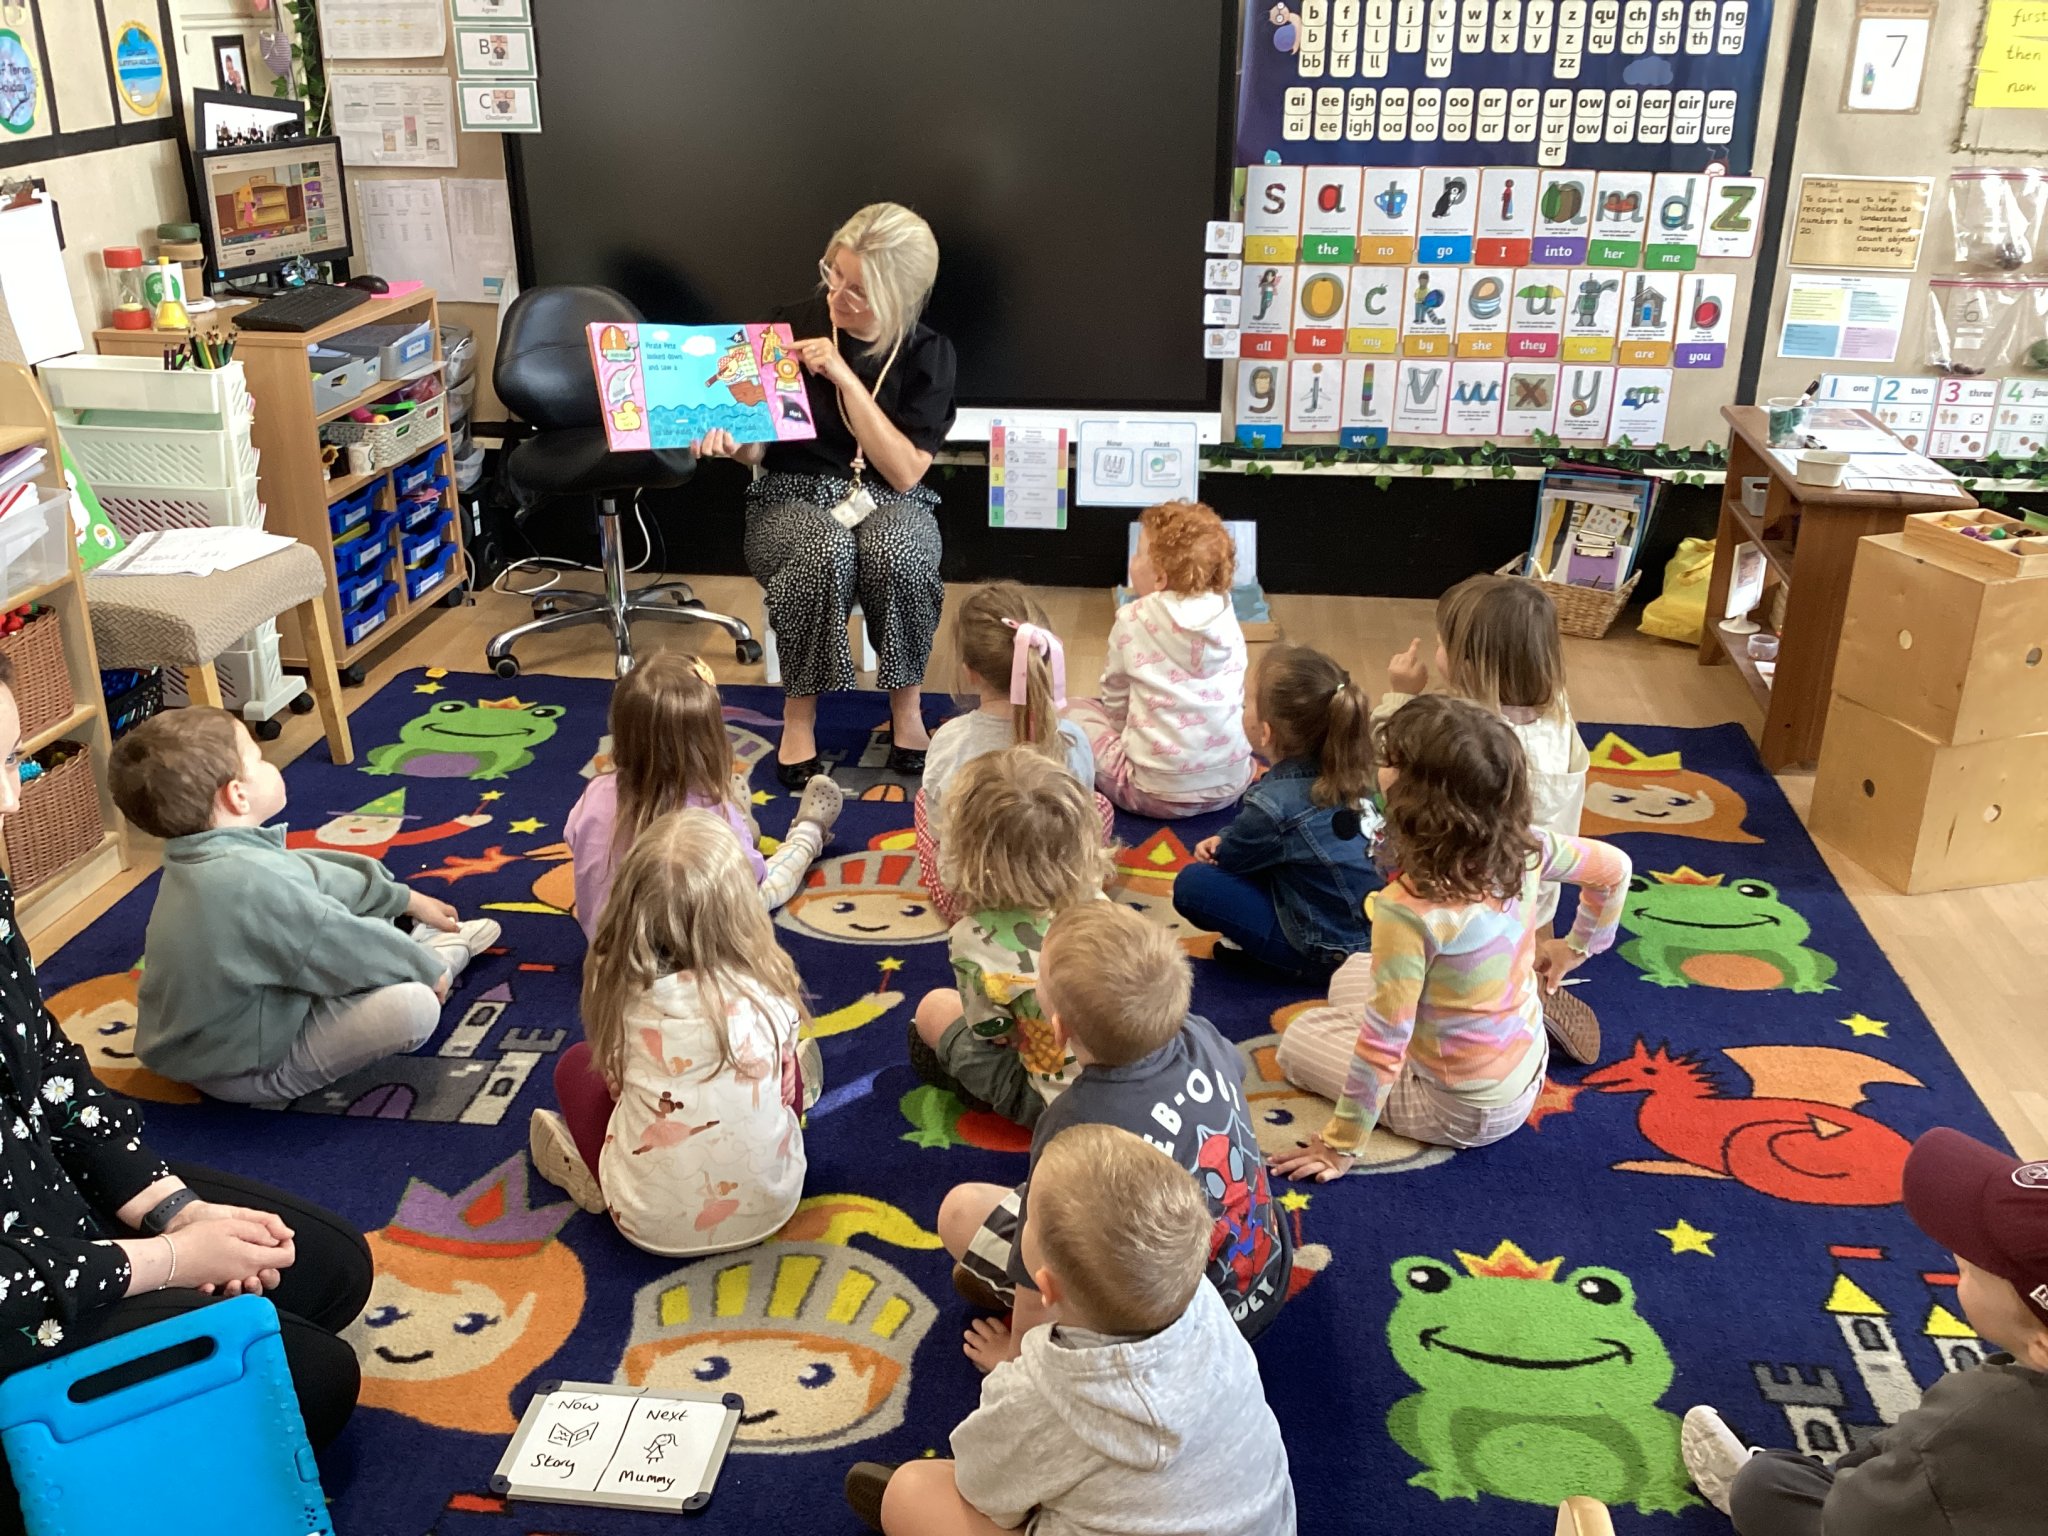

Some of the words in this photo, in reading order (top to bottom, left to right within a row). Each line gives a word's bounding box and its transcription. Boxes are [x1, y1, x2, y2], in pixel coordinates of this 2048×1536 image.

[1309, 6, 1319, 19] b
[1343, 6, 1351, 19] f
[1375, 6, 1382, 19] l
[1406, 6, 1413, 24] j
[1438, 10, 1447, 19] v
[1468, 10, 1482, 19] w
[1502, 9, 1512, 20] x
[1535, 10, 1545, 24] y
[1569, 10, 1576, 20] z
[1595, 10, 1616, 24] qu
[1629, 7, 1647, 21] ch
[1662, 7, 1679, 21] sh
[1695, 7, 1712, 22] th
[1725, 10, 1745, 25] ng
[479, 39, 490, 54] B
[1308, 30, 1318, 42] b
[1342, 30, 1348, 42] f
[1374, 30, 1380, 43] l
[1405, 30, 1411, 47] j
[1437, 33, 1446, 43] v
[1466, 33, 1479, 43] w
[1500, 33, 1510, 43] x
[1533, 34, 1542, 48] y
[1566, 34, 1574, 44] z
[1593, 34, 1612, 49] qu
[1627, 32, 1644, 45] ch
[1659, 32, 1676, 45] sh
[1692, 32, 1708, 45] th
[1722, 35, 1742, 49] ng
[1886, 35, 1908, 68] 7
[2006, 45, 2041, 60] then
[1302, 56, 1321, 68] bb
[1337, 56, 1350, 68] ff
[1370, 56, 1380, 68] ll
[1431, 58, 1447, 67] vv
[1560, 59, 1575, 68] zz
[2007, 81, 2036, 93] now
[480, 93, 491, 109] C
[1291, 93, 1306, 106] ai
[1321, 97, 1339, 107] ee
[1350, 94, 1374, 110] igh
[1385, 97, 1405, 107] oa
[1417, 97, 1436, 107] oo
[1450, 97, 1469, 107] oo
[1484, 97, 1501, 107] ar
[1516, 97, 1534, 108] or
[1550, 98, 1567, 108] ur
[1578, 98, 1603, 108] ow
[1616, 96, 1631, 109] oi
[1643, 98, 1670, 109] ear
[1678, 96, 1701, 110] air
[1709, 99, 1734, 110] ure
[1290, 119, 1303, 132] ai
[1320, 122, 1337, 132] ee
[1349, 119, 1372, 136] igh
[1383, 123, 1402, 132] oa
[1416, 123, 1434, 132] oo
[1447, 123, 1466, 132] oo
[1482, 123, 1498, 133] ar
[1514, 123, 1531, 133] or
[1547, 123, 1564, 134] ur
[1576, 124, 1599, 134] ow
[1613, 121, 1627, 134] oi
[1641, 124, 1666, 135] ear
[1675, 122, 1696, 135] air
[1706, 124, 1731, 135] ure
[1545, 146, 1560, 156] er
[1264, 246, 1276, 254] to
[1318, 243, 1339, 255] the
[1378, 246, 1394, 255] no
[1437, 246, 1453, 258] go
[1500, 247, 1506, 257] I
[1545, 246, 1572, 256] into
[1604, 248, 1624, 259] her
[1662, 254, 1680, 262] me
[1256, 340, 1271, 351] all
[1312, 336, 1326, 346] he
[1363, 338, 1381, 347] my
[1419, 340, 1434, 351] by
[1472, 340, 1492, 349] she
[1520, 340, 1546, 352] they
[1580, 346, 1596, 354] we
[1635, 350, 1654, 358] are
[1689, 353, 1711, 363] you
[1830, 378, 1838, 398] 1
[1884, 380, 1900, 400] 2
[1945, 382, 1960, 402] 3
[1969, 389, 1993, 397] three
[2008, 383, 2023, 402] 4
[558, 1399, 599, 1411] Now
[646, 1410, 688, 1422] Next
[531, 1454, 575, 1478] Story
[619, 1471, 675, 1492] Mummy
